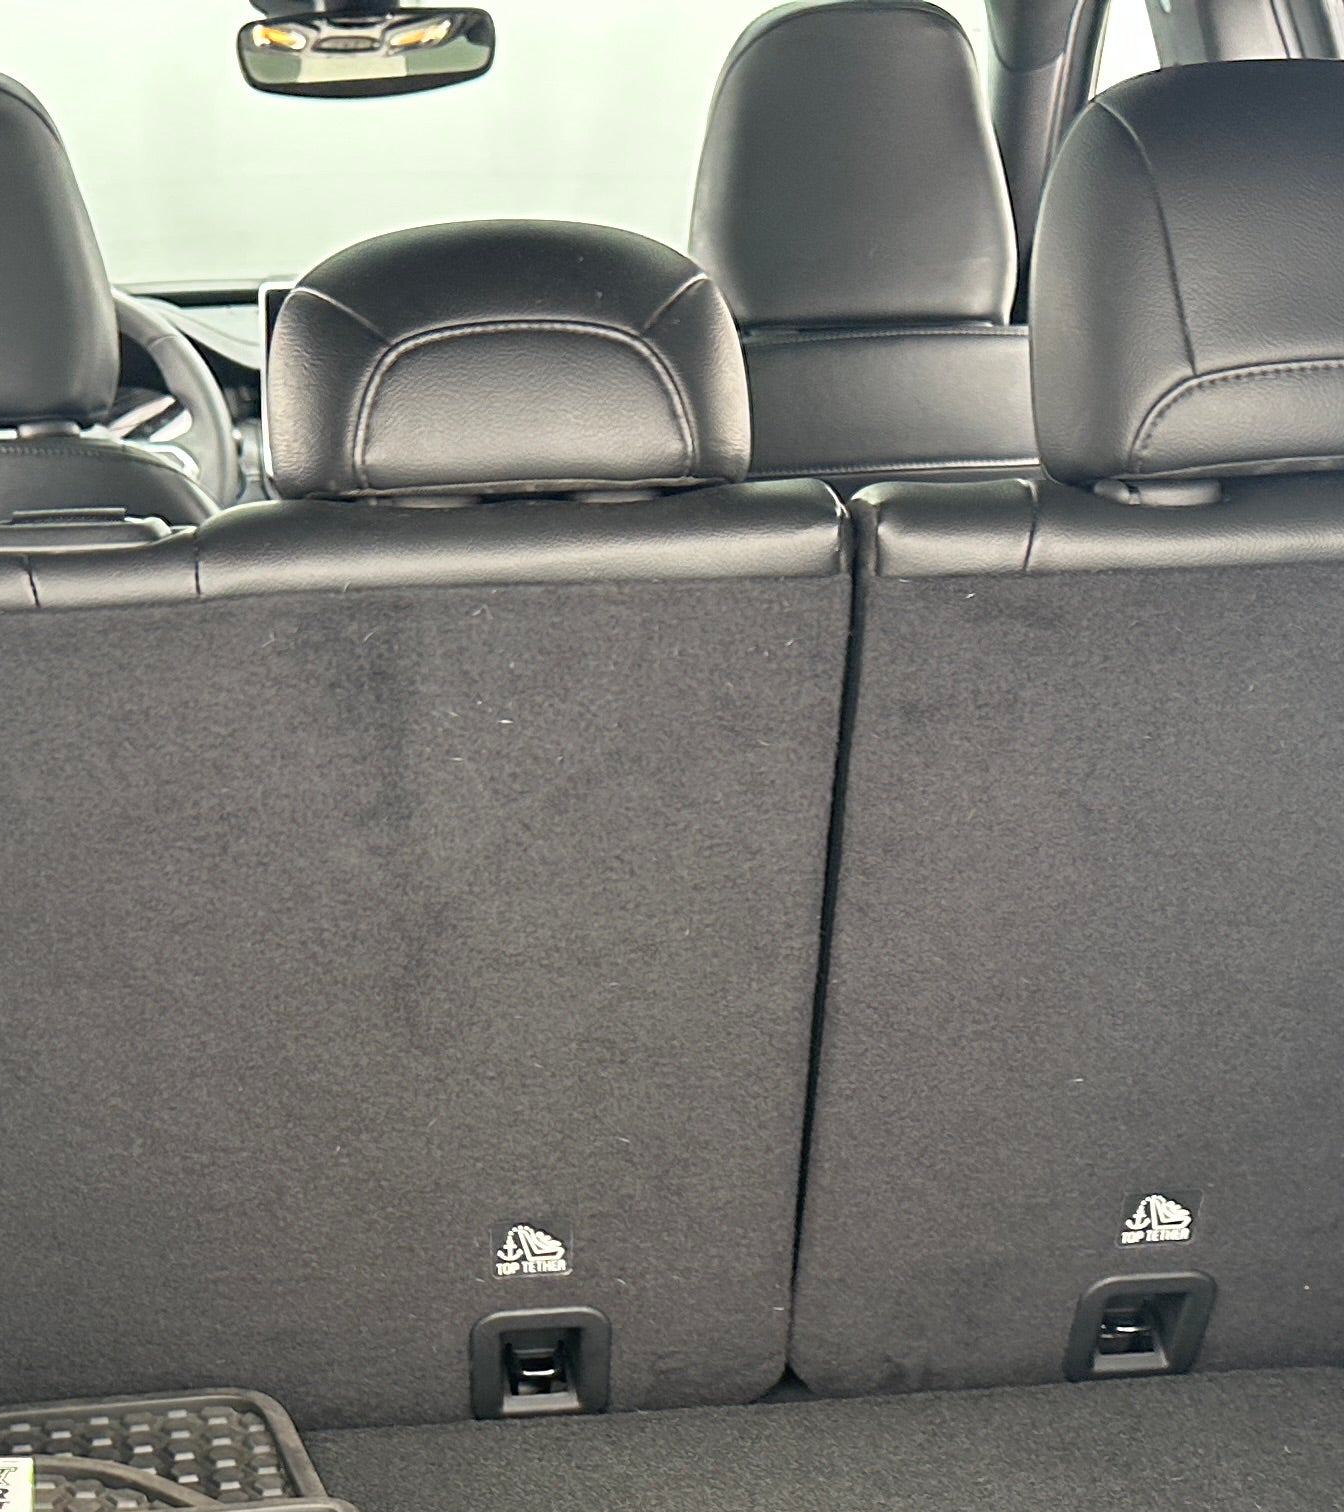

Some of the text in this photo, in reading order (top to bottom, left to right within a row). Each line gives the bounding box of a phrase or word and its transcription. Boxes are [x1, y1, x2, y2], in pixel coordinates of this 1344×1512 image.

[1121, 1228, 1190, 1244] TOP TETHER
[496, 1260, 566, 1275] TOP TETHER
